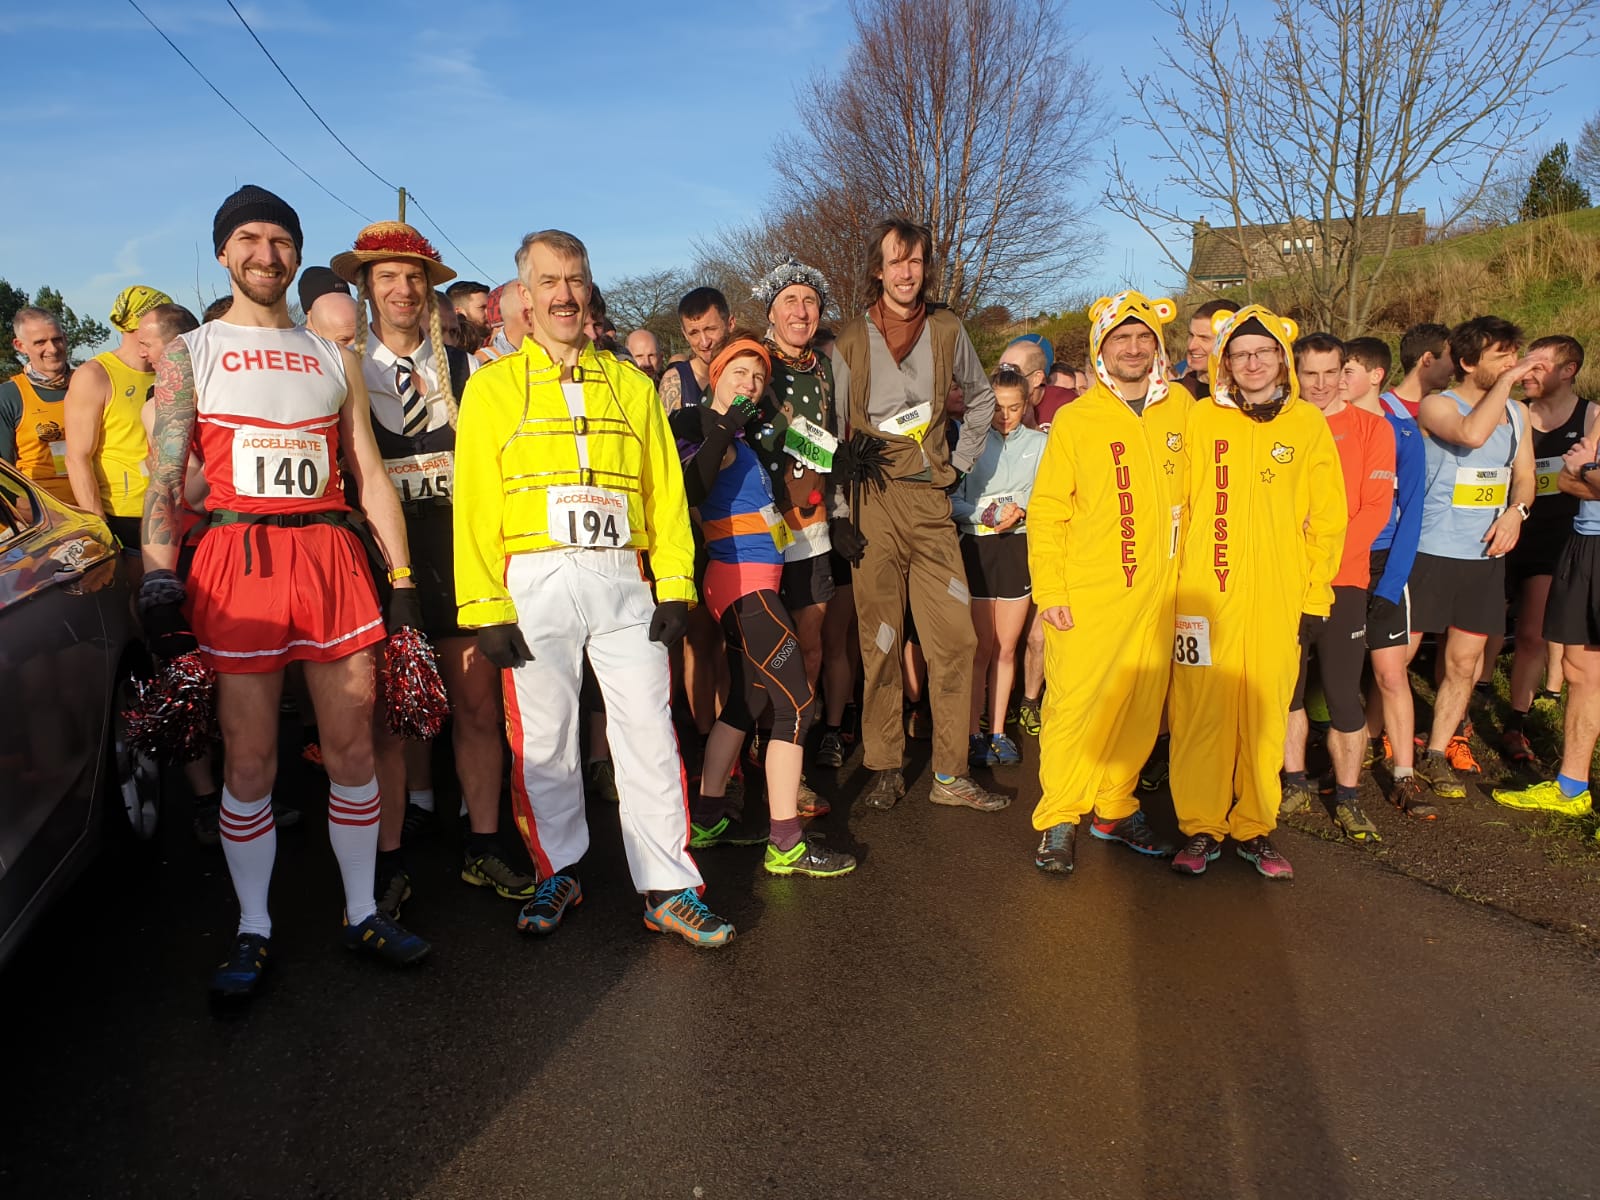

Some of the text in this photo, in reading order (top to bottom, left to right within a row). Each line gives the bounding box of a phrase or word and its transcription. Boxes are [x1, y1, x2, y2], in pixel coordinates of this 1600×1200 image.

[222, 349, 324, 376] CHEER
[242, 437, 322, 452] ACCELERATE
[256, 456, 318, 496] 140
[388, 457, 449, 474] ACCELERATE
[402, 476, 450, 500] 145
[556, 494, 623, 508] ACCELERATE
[1474, 488, 1494, 502] 28
[568, 510, 620, 546] 194
[1110, 441, 1138, 588] PUDSEY
[1214, 439, 1230, 593] PUDSEY
[1176, 634, 1200, 664] 38
